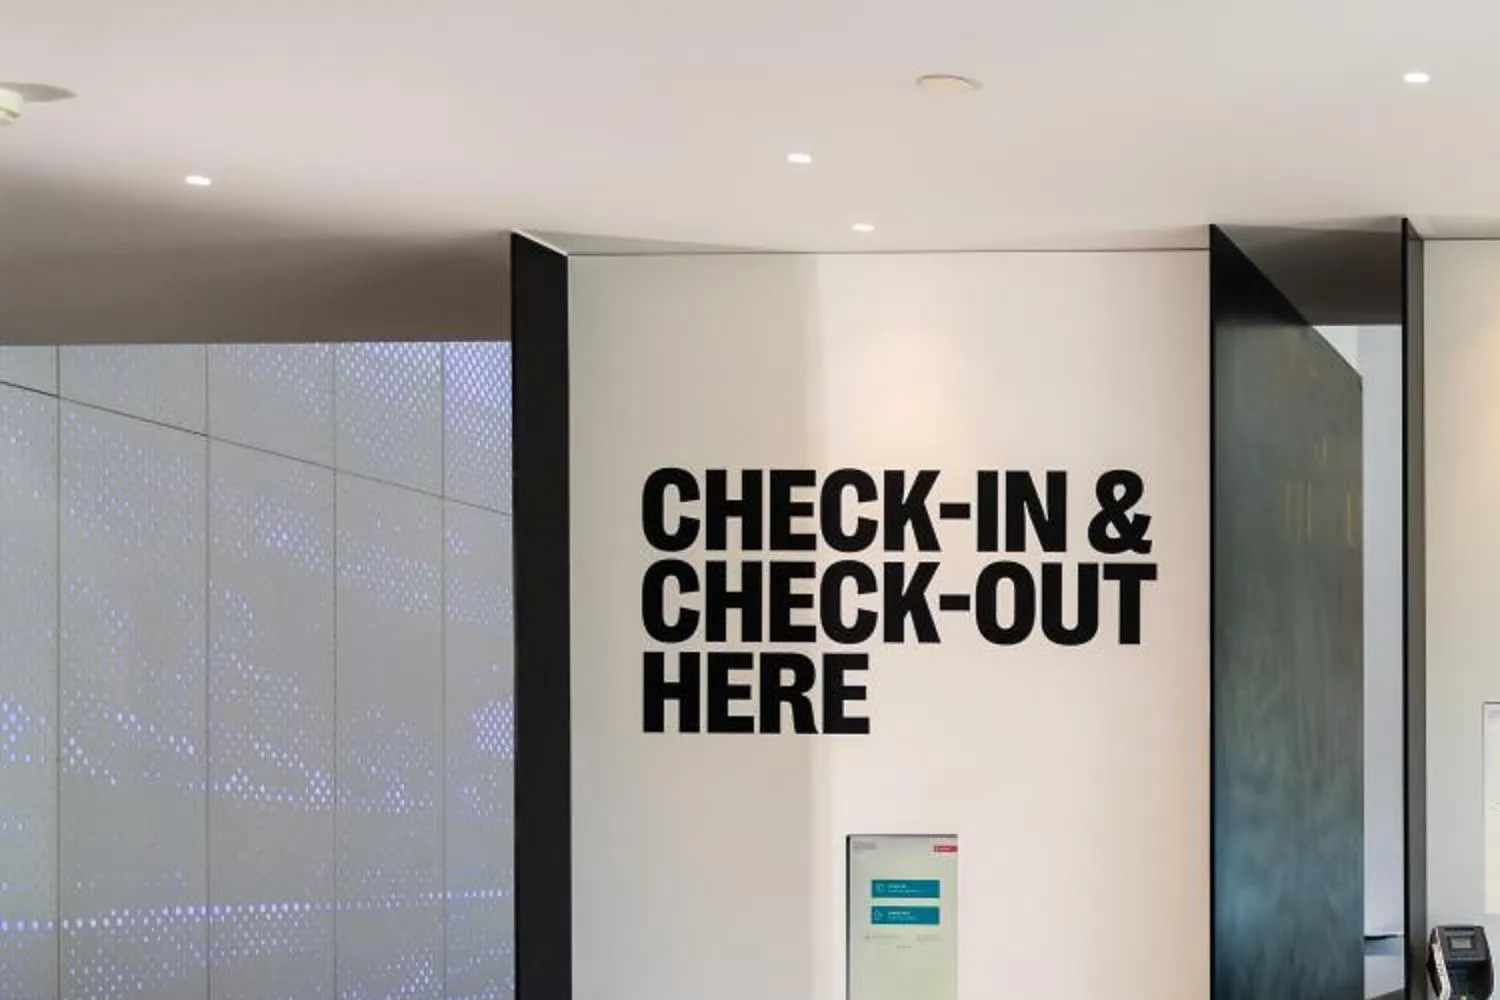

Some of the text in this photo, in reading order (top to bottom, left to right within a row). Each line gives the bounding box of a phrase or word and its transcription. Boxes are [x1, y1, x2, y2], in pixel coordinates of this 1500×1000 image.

[642, 467, 1152, 554] CHECK-IN &
[642, 559, 1157, 646] CHECK-OUT
[642, 651, 870, 734] HERE
